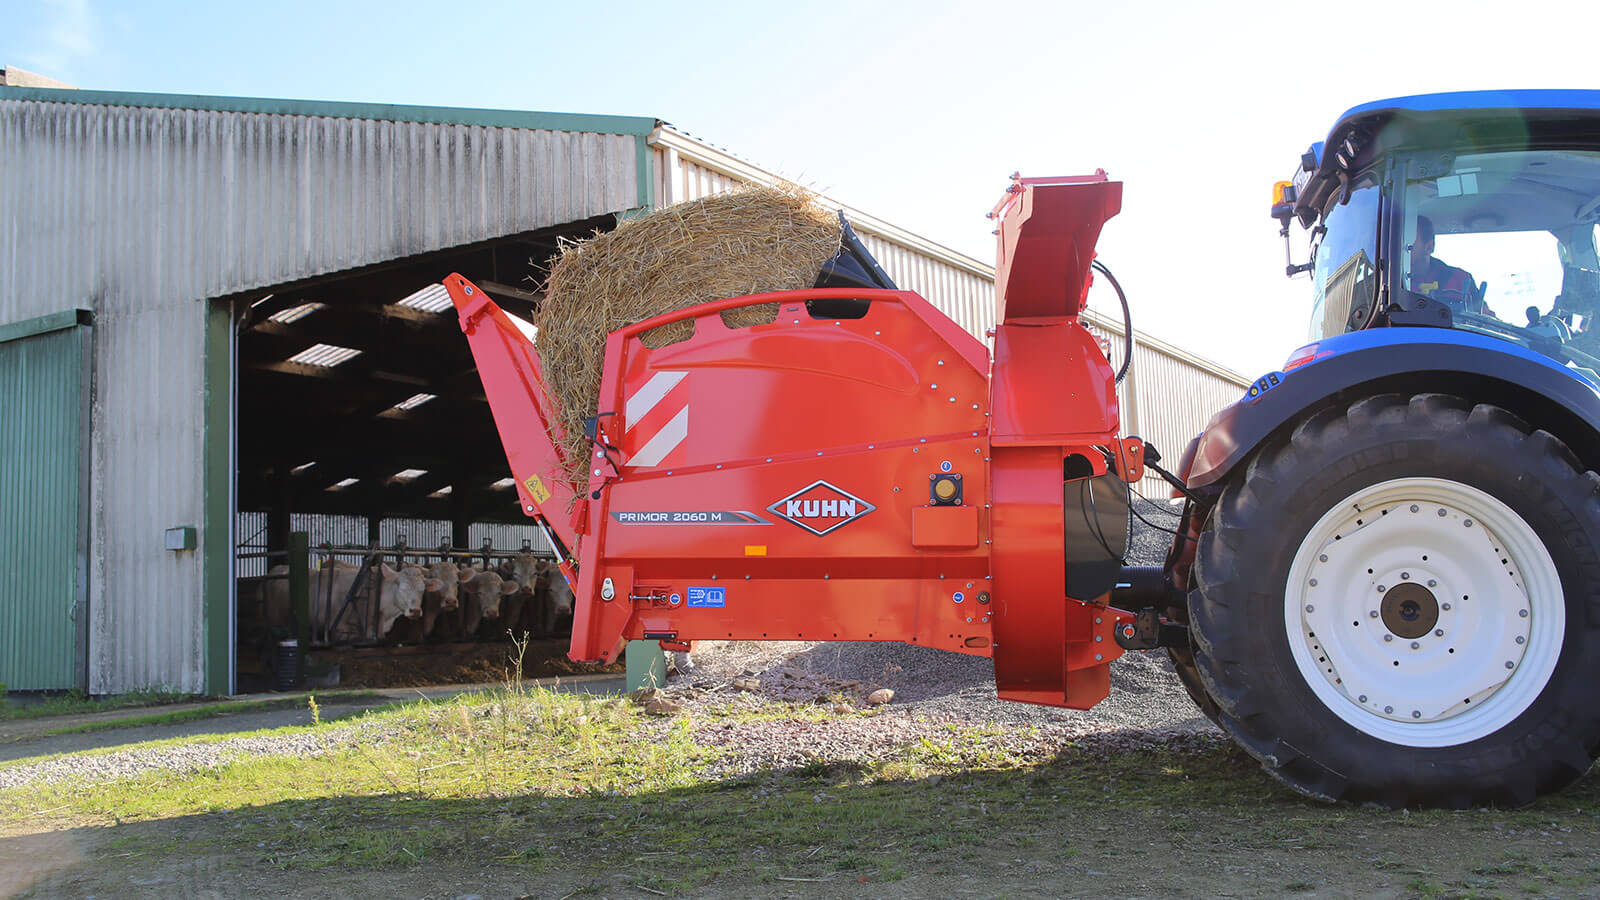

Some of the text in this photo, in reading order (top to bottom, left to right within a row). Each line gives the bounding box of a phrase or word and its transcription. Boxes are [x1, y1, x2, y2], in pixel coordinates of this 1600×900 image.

[786, 499, 856, 518] KUHN
[619, 512, 722, 522] PRIMOR 2060 M
